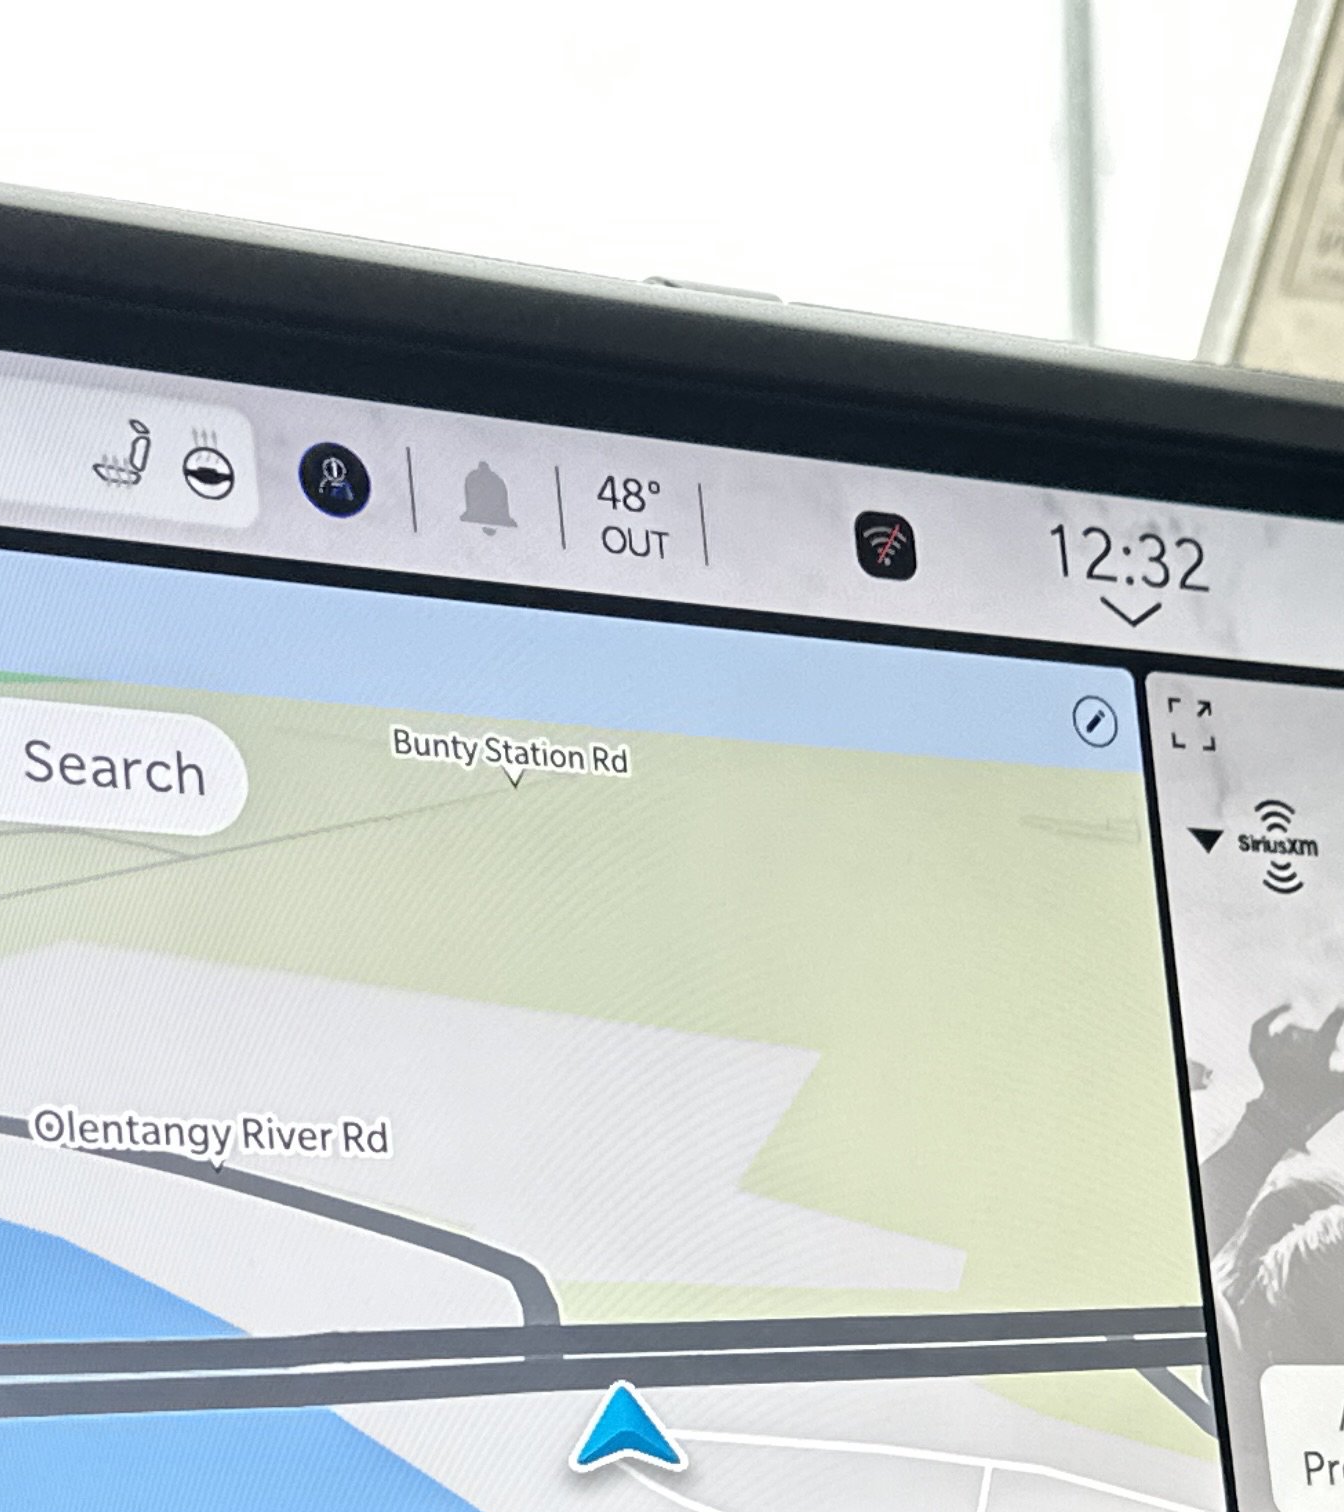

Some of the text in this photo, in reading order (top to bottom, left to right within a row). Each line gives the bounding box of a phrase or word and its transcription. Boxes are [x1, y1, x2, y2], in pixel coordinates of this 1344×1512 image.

[596, 474, 662, 514] 48°
[600, 525, 673, 561] OUT
[1049, 523, 1211, 593] 12:32
[24, 736, 206, 797] Search
[392, 727, 628, 775] Bunty Station Rd
[34, 1109, 388, 1157] Olentangy River Rd
